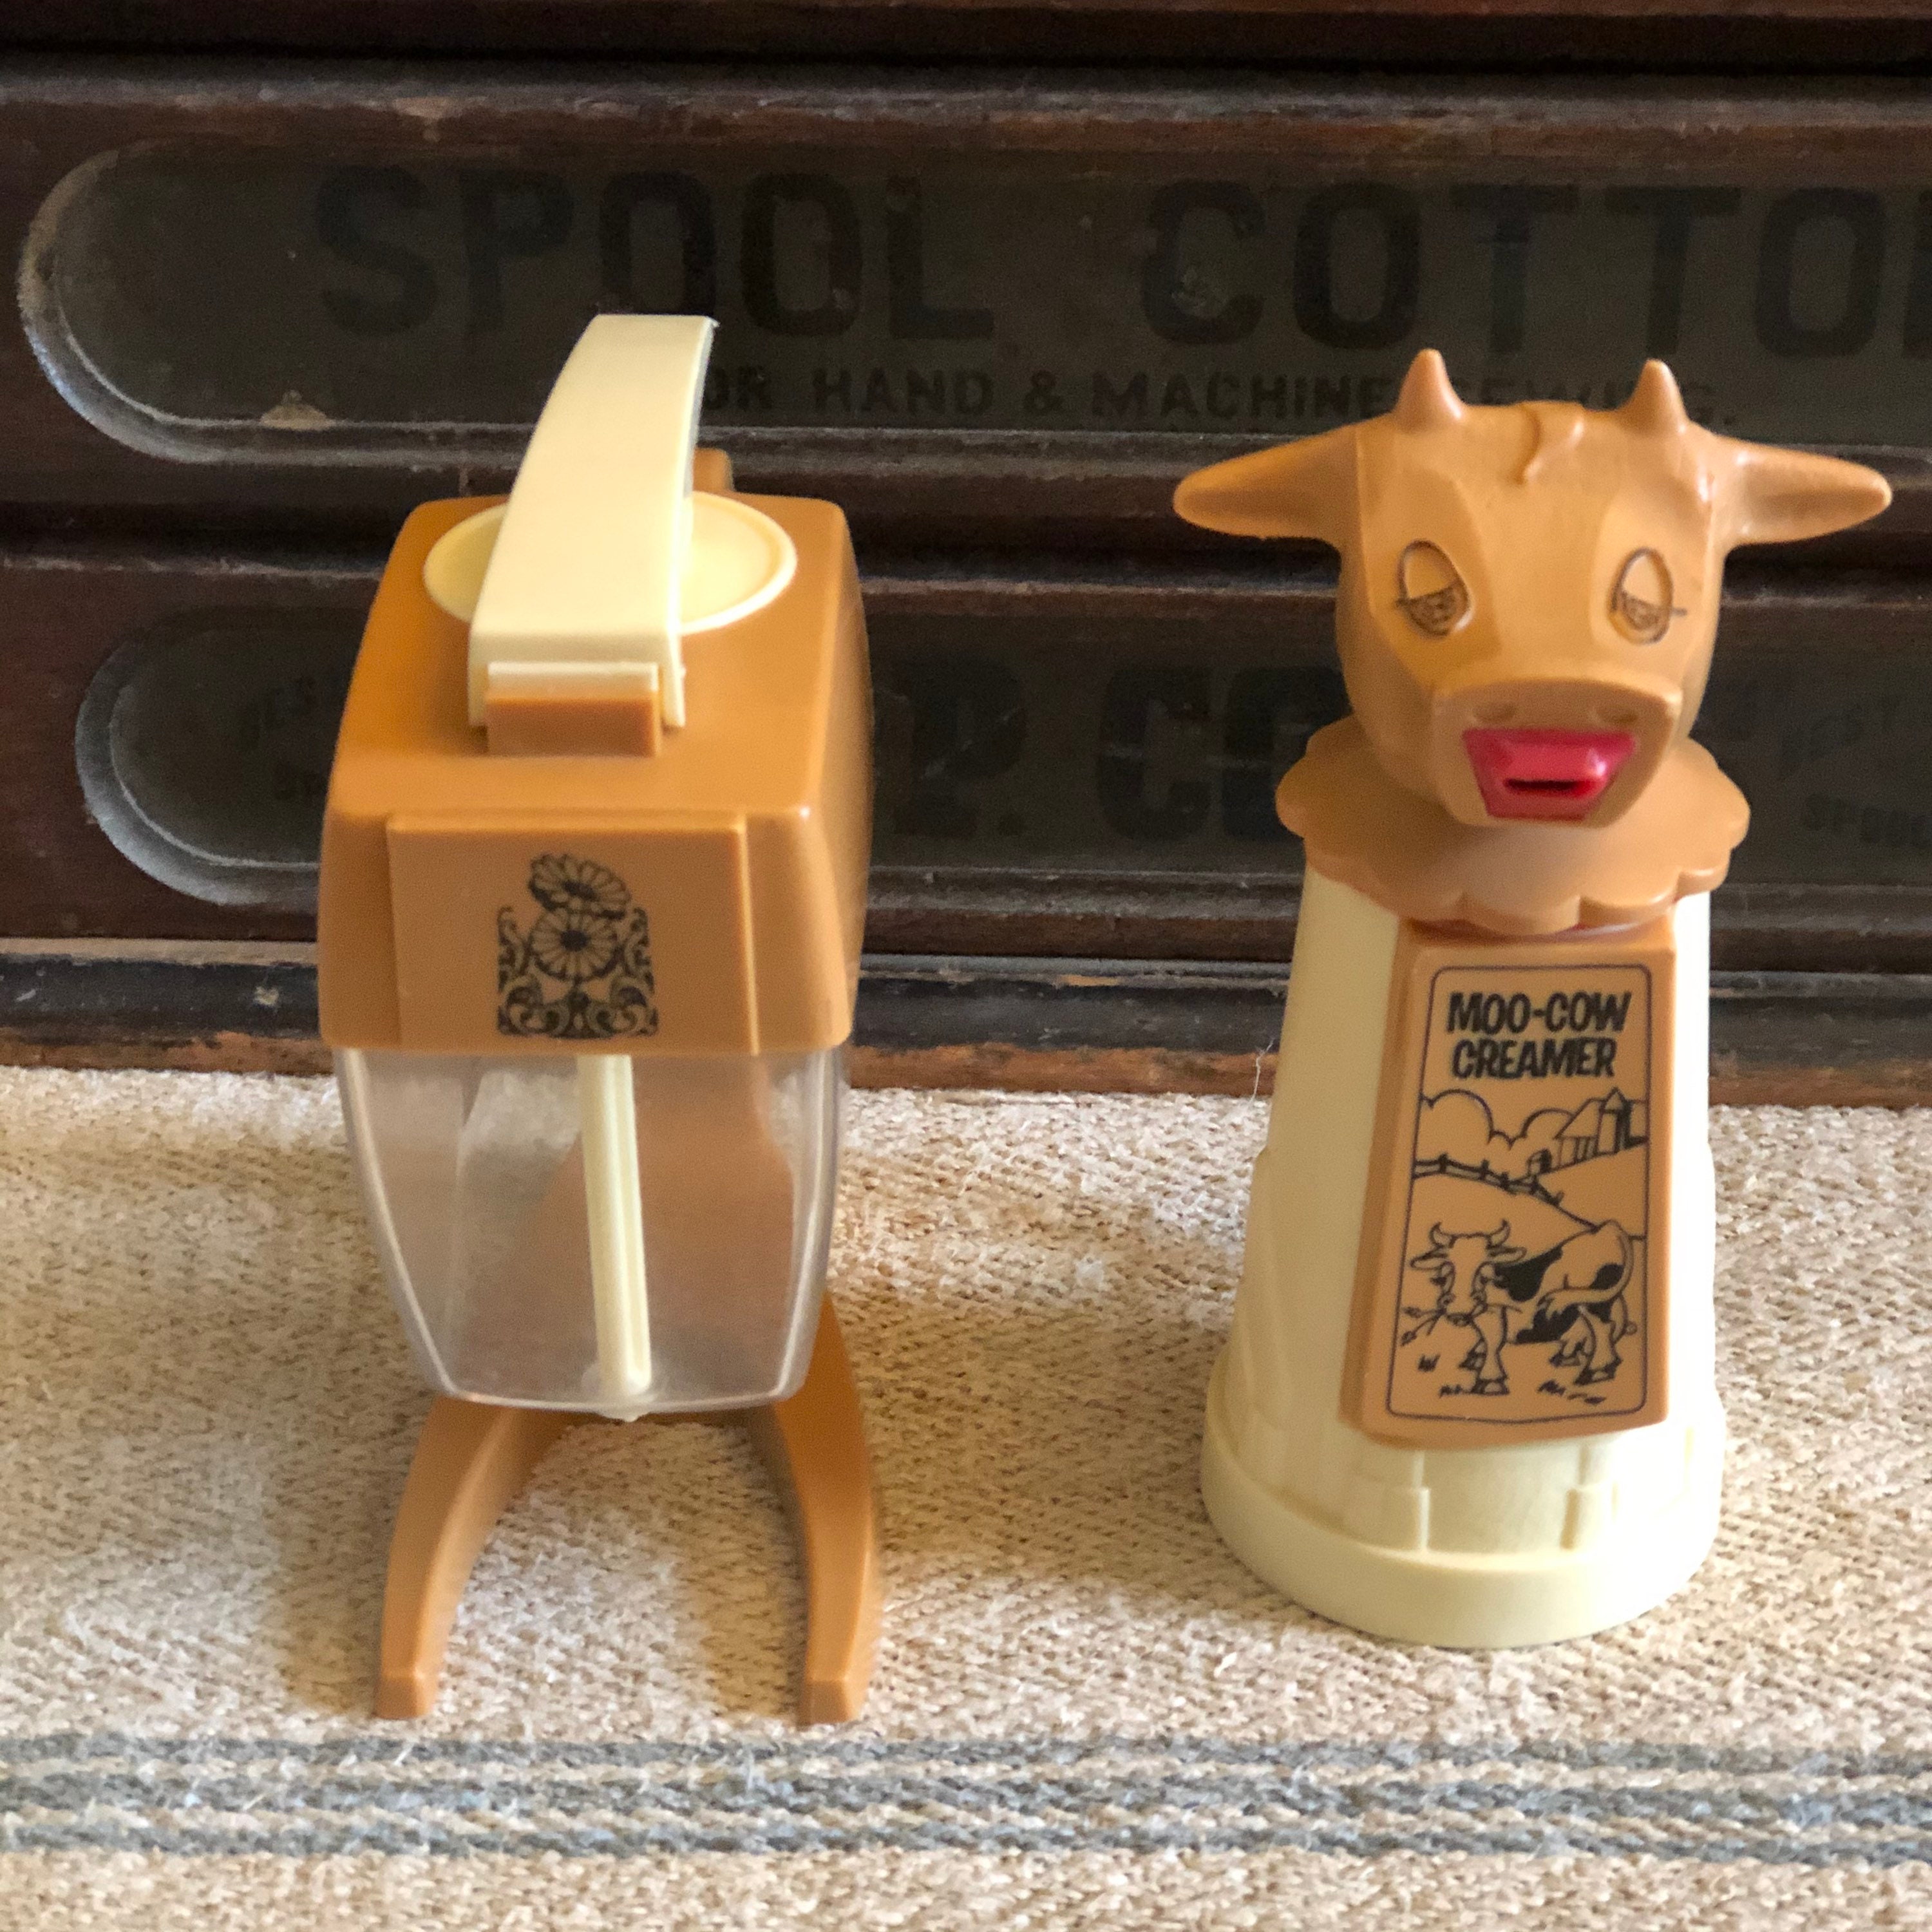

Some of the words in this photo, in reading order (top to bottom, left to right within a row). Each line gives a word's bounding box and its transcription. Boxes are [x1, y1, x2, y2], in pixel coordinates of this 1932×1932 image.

[313, 164, 995, 340] SPOOL
[811, 366, 996, 417] HAND
[1023, 368, 1066, 415] &
[1090, 369, 1394, 420] MACHINE
[1446, 990, 1632, 1036] MOO-COW
[1452, 1036, 1618, 1081] CREAMER
